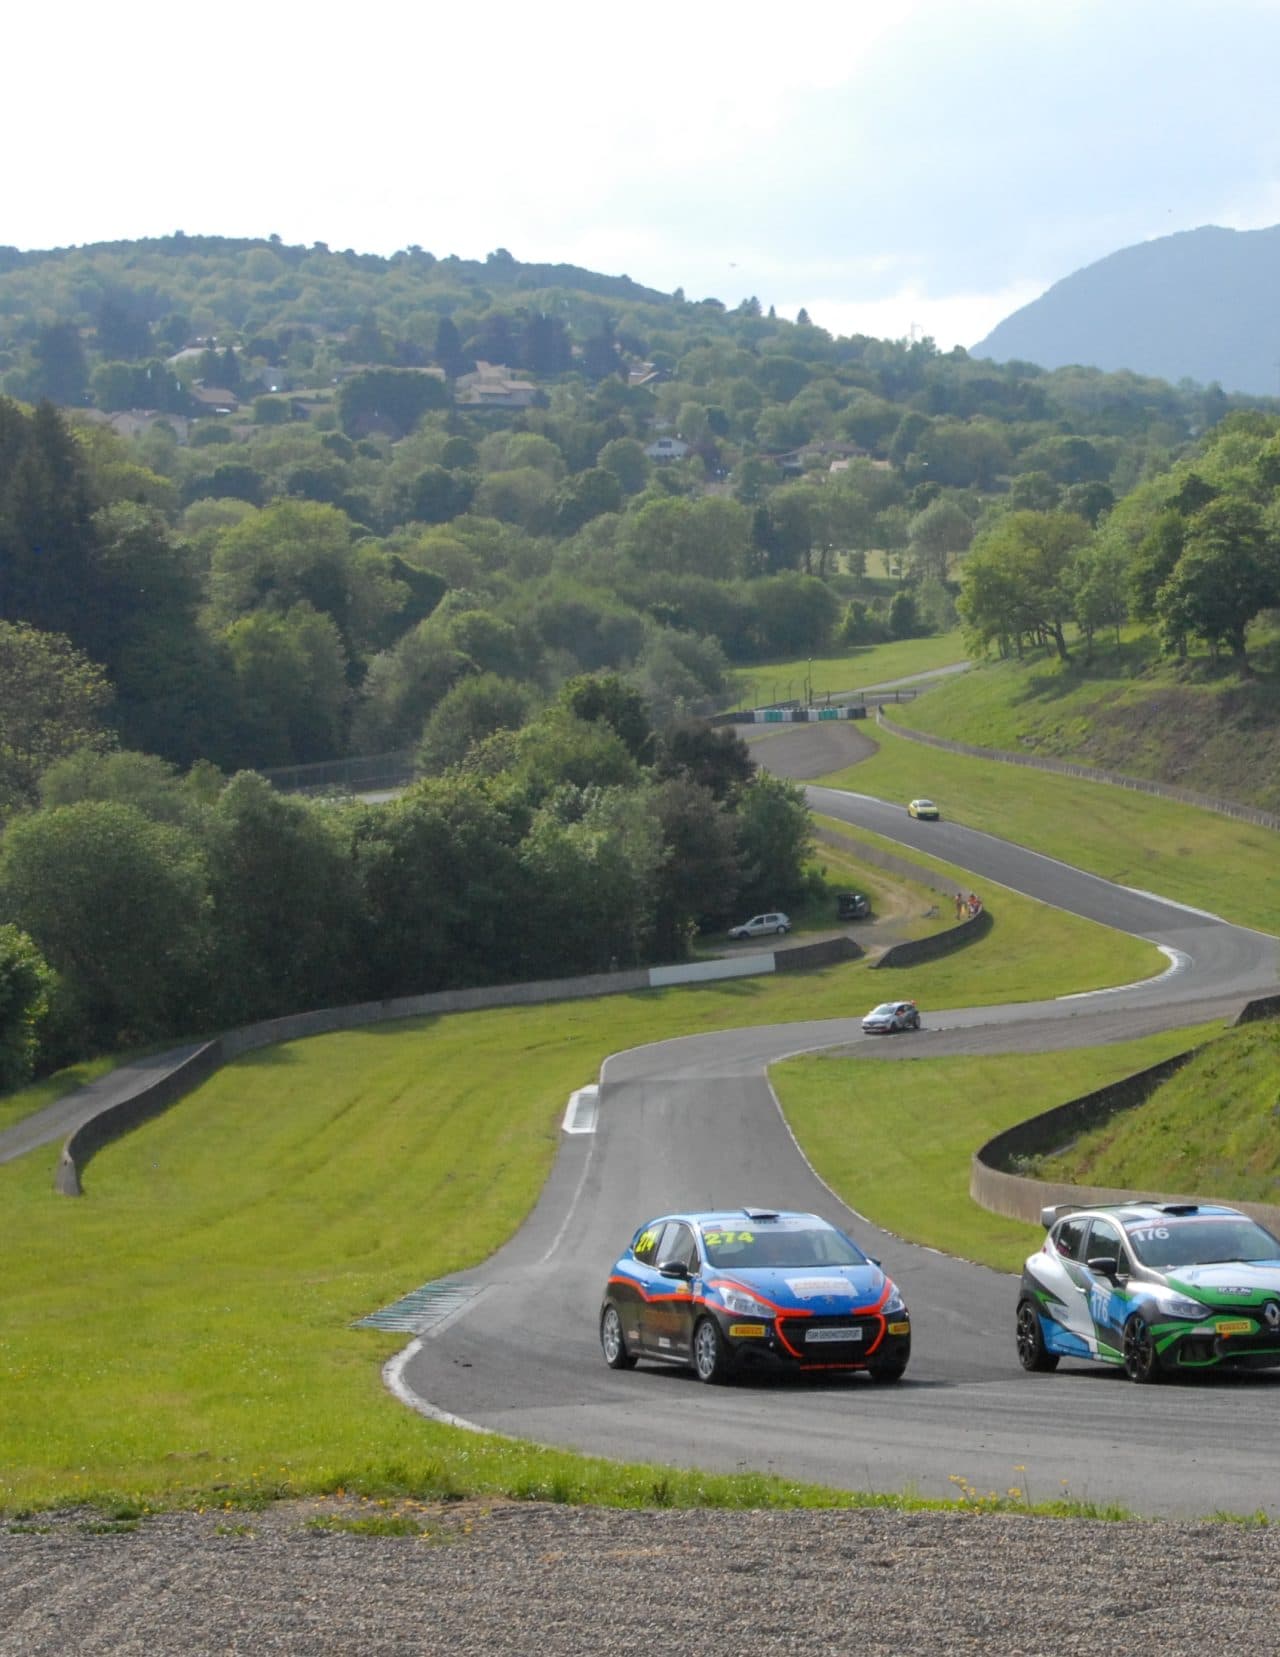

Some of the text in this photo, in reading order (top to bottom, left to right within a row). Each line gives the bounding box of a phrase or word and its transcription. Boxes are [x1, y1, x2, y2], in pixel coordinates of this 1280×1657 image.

[704, 1231, 754, 1246] 274
[1130, 1227, 1170, 1242] 176
[1091, 1294, 1108, 1322] 176
